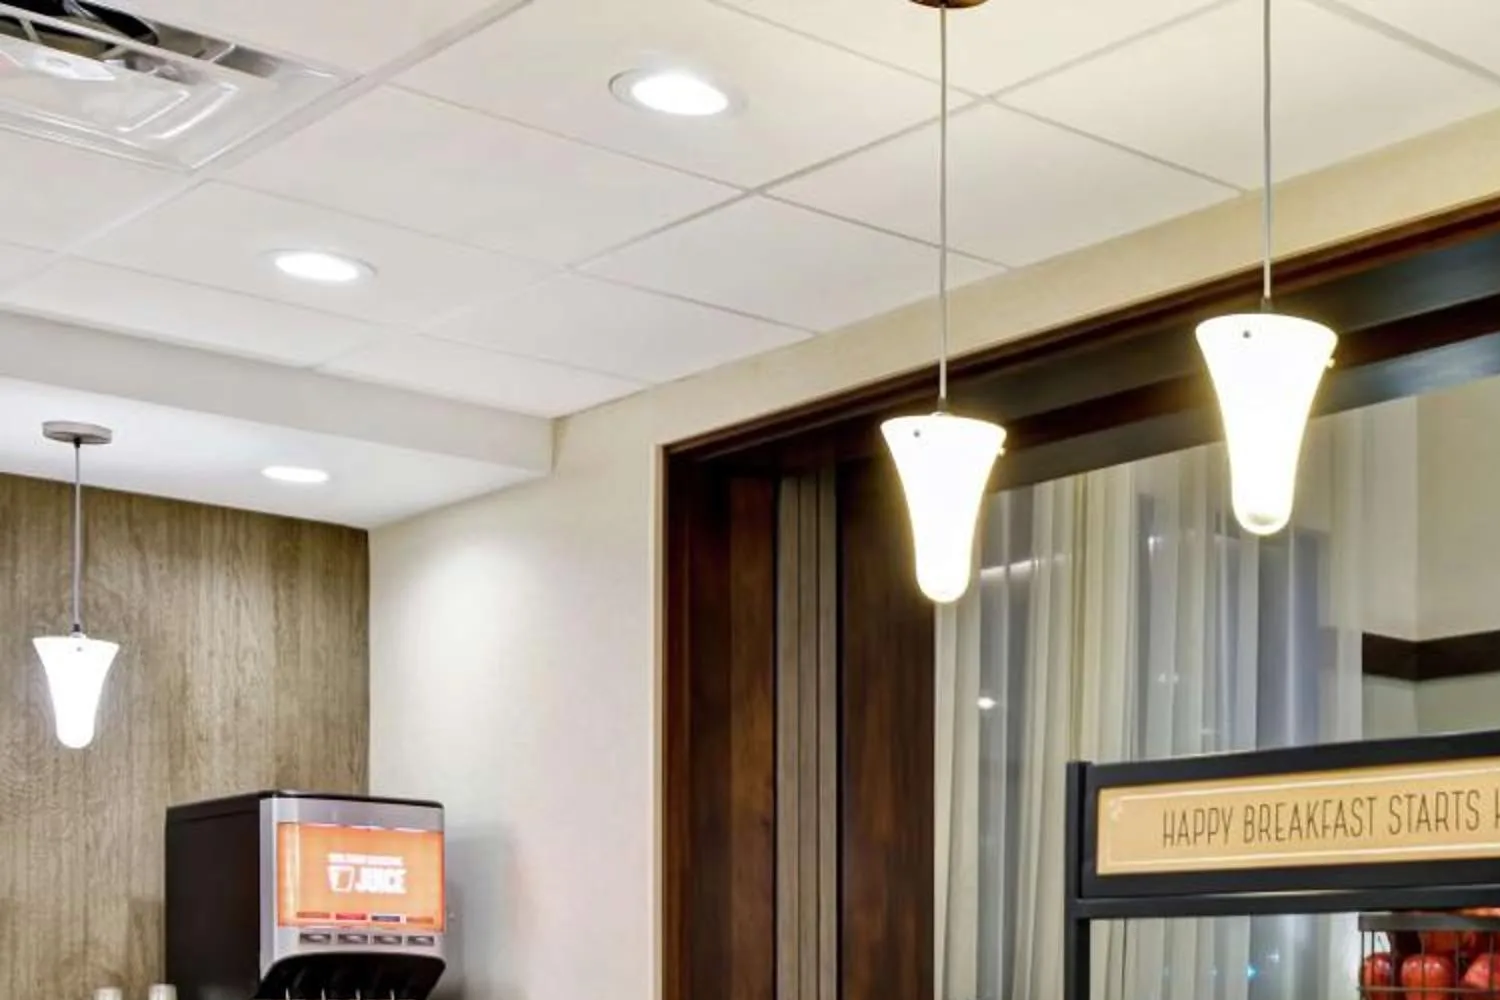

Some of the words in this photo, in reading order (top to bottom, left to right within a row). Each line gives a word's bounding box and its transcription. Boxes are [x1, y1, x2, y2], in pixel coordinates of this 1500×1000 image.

[1162, 807, 1235, 848] HAPPY
[1243, 795, 1378, 844] BREAKFAST
[1388, 789, 1481, 836] STARTS
[355, 867, 405, 894] JUICE
